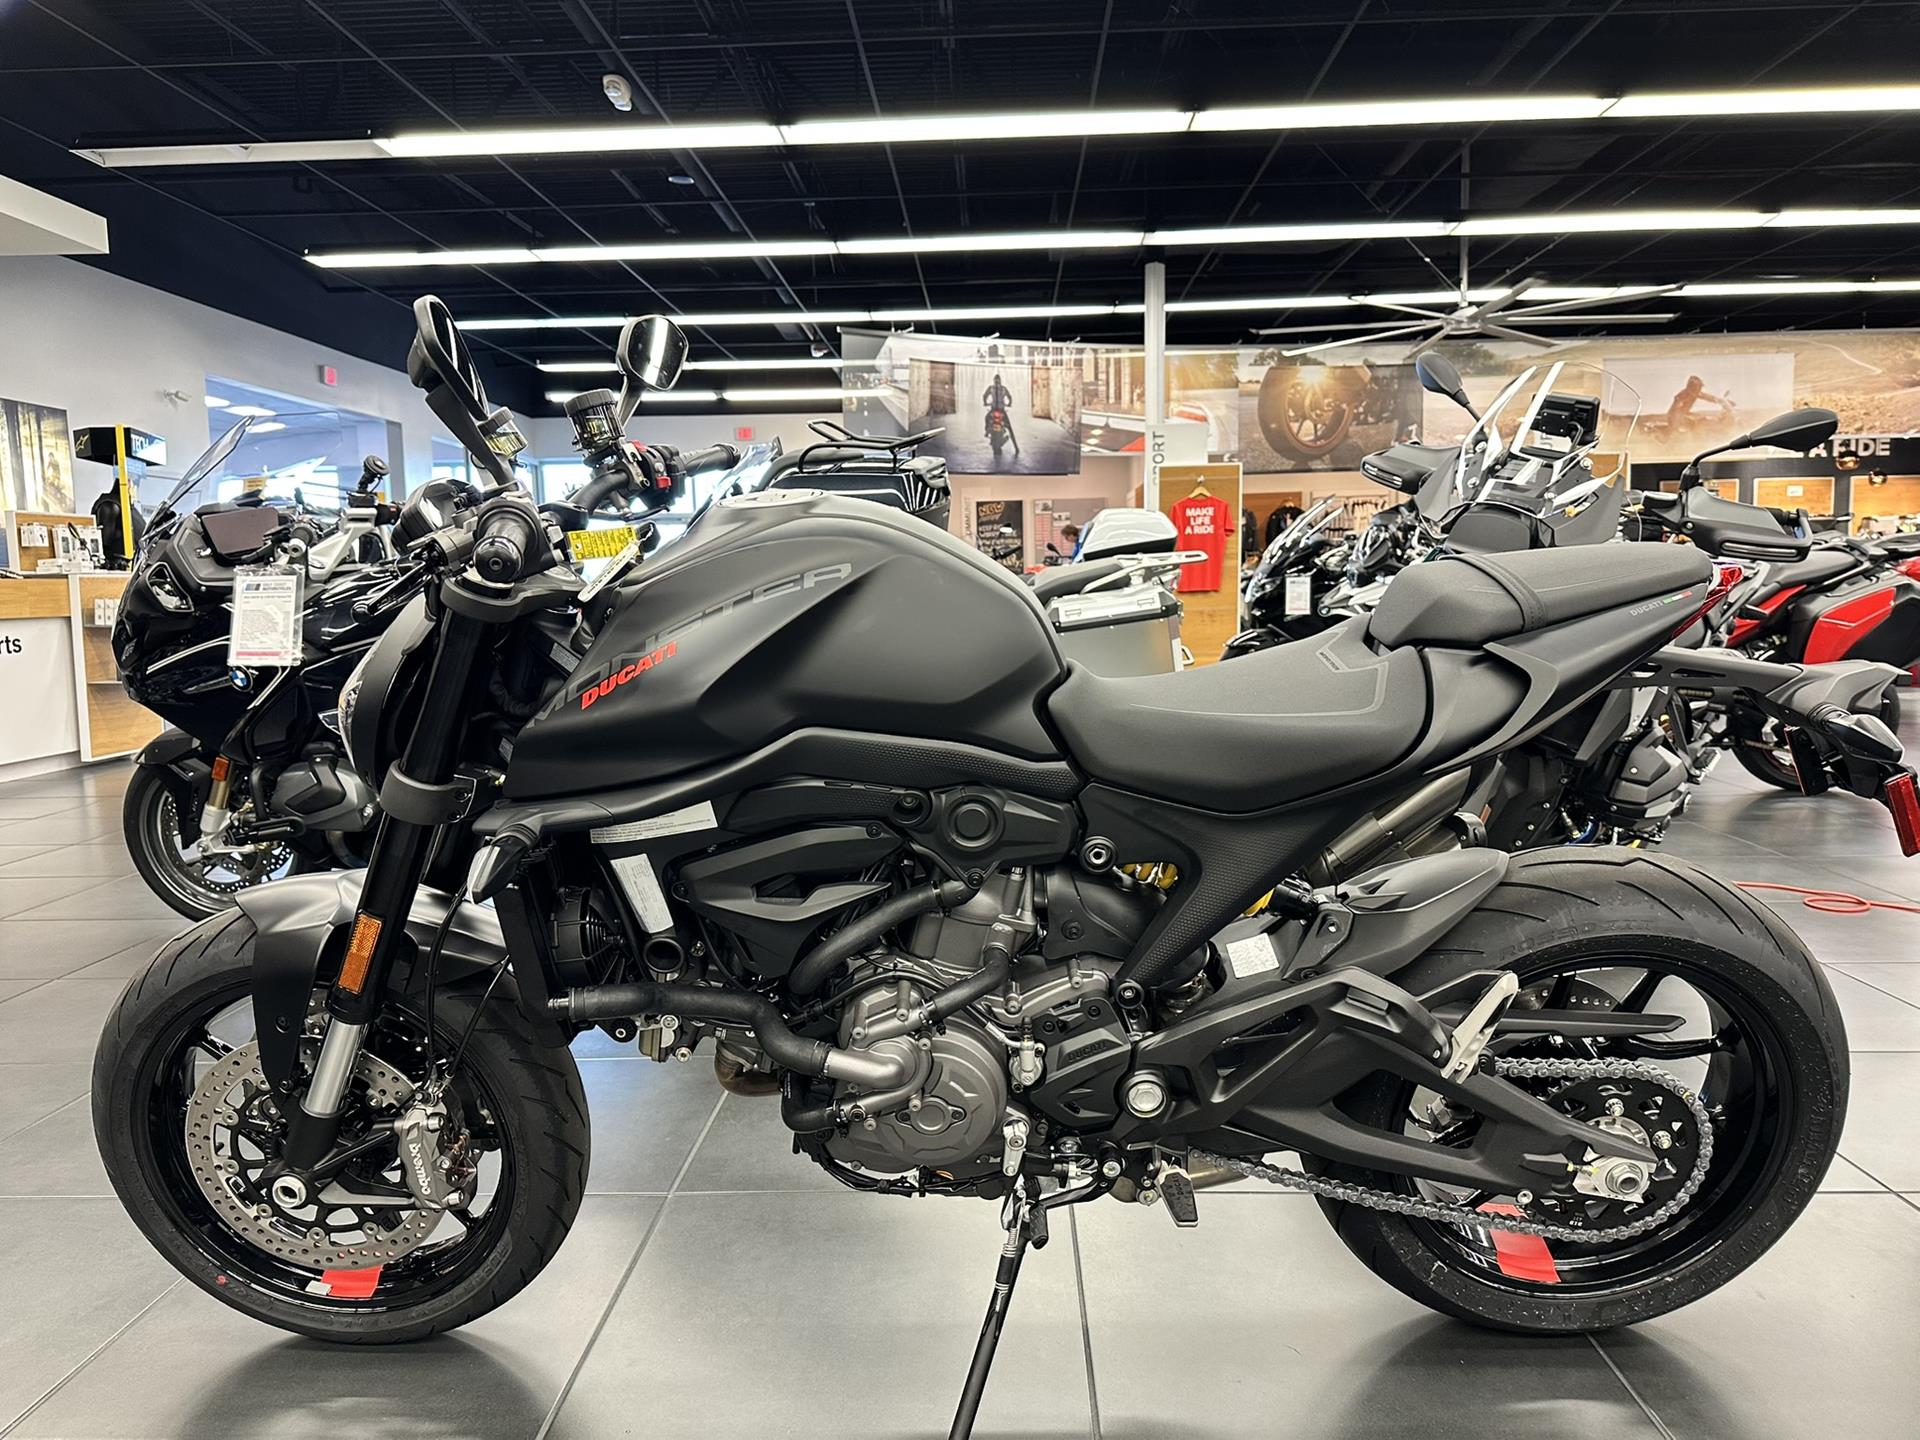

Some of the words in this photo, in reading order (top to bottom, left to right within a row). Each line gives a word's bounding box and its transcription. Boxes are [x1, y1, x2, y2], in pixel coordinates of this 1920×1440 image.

[1186, 507, 1214, 517] MAKE
[1190, 516, 1211, 526] LIFE
[1185, 526, 1192, 535] A
[1194, 525, 1214, 534] RIDE
[1630, 600, 1663, 616] DUCATI
[581, 640, 676, 710] DUCATI
[409, 1143, 431, 1195] brembo
